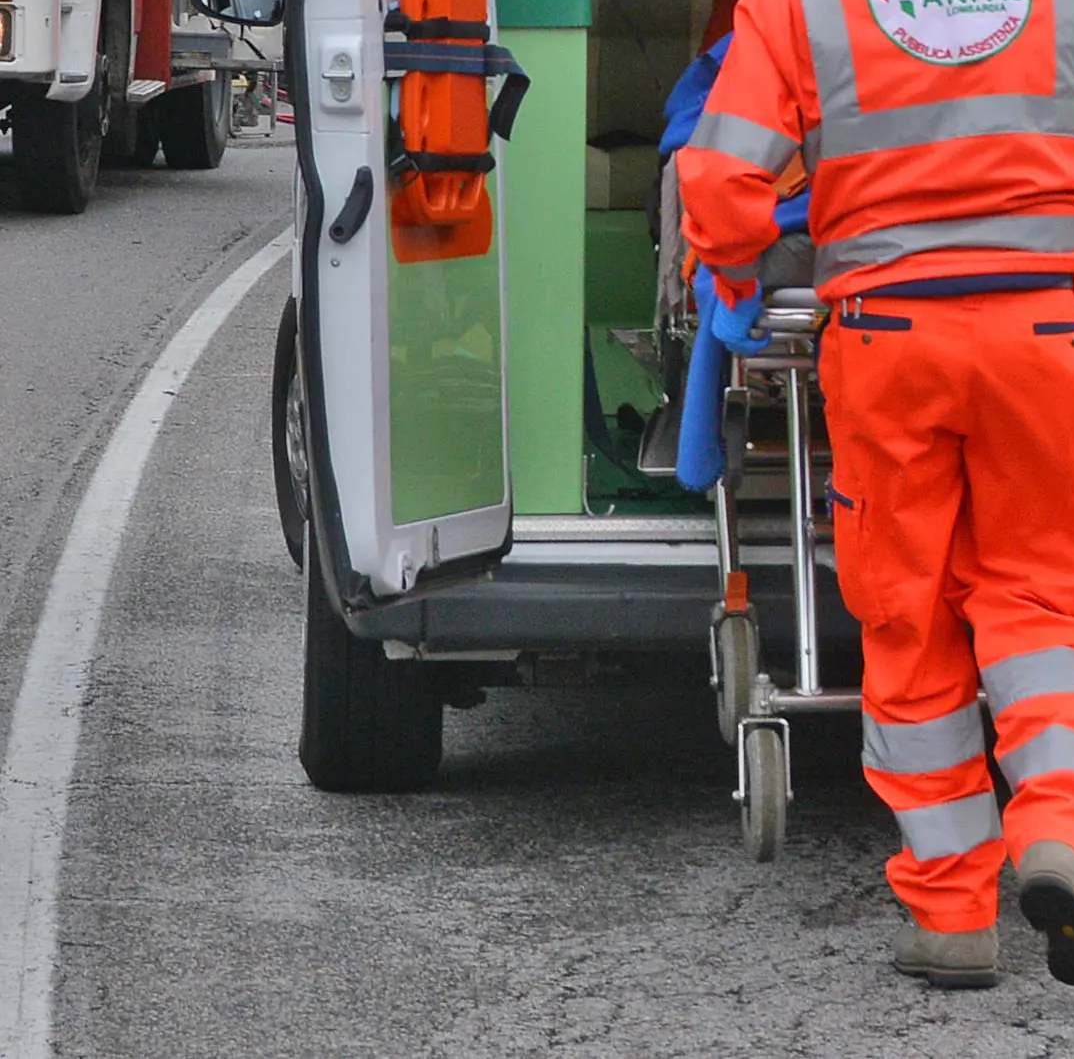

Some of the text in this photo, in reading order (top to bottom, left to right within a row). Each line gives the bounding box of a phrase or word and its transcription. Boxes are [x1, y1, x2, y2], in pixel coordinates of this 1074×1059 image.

[946, 3, 1008, 17] LOMBARDIA
[893, 16, 1021, 60] PUBBLICA ASSISTENZA
